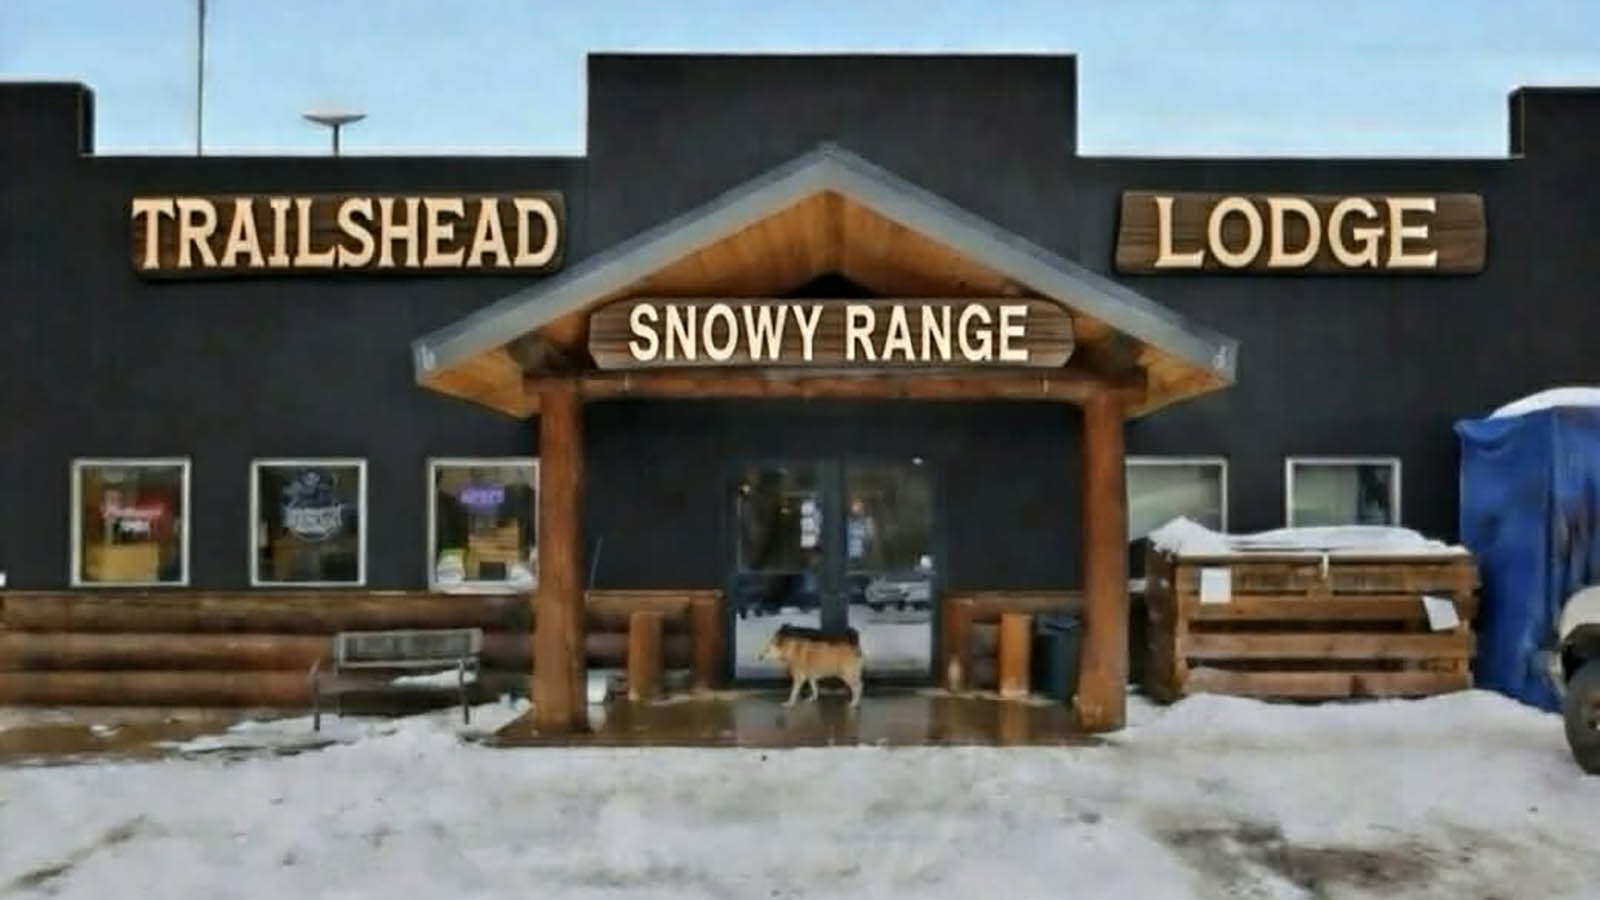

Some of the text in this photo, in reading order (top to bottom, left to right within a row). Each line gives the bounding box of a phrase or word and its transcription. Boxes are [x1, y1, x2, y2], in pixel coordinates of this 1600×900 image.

[132, 197, 560, 270] TRAILSHEAD
[1154, 197, 1438, 268] LODGE
[628, 303, 1029, 361] SNOWY RANGE
